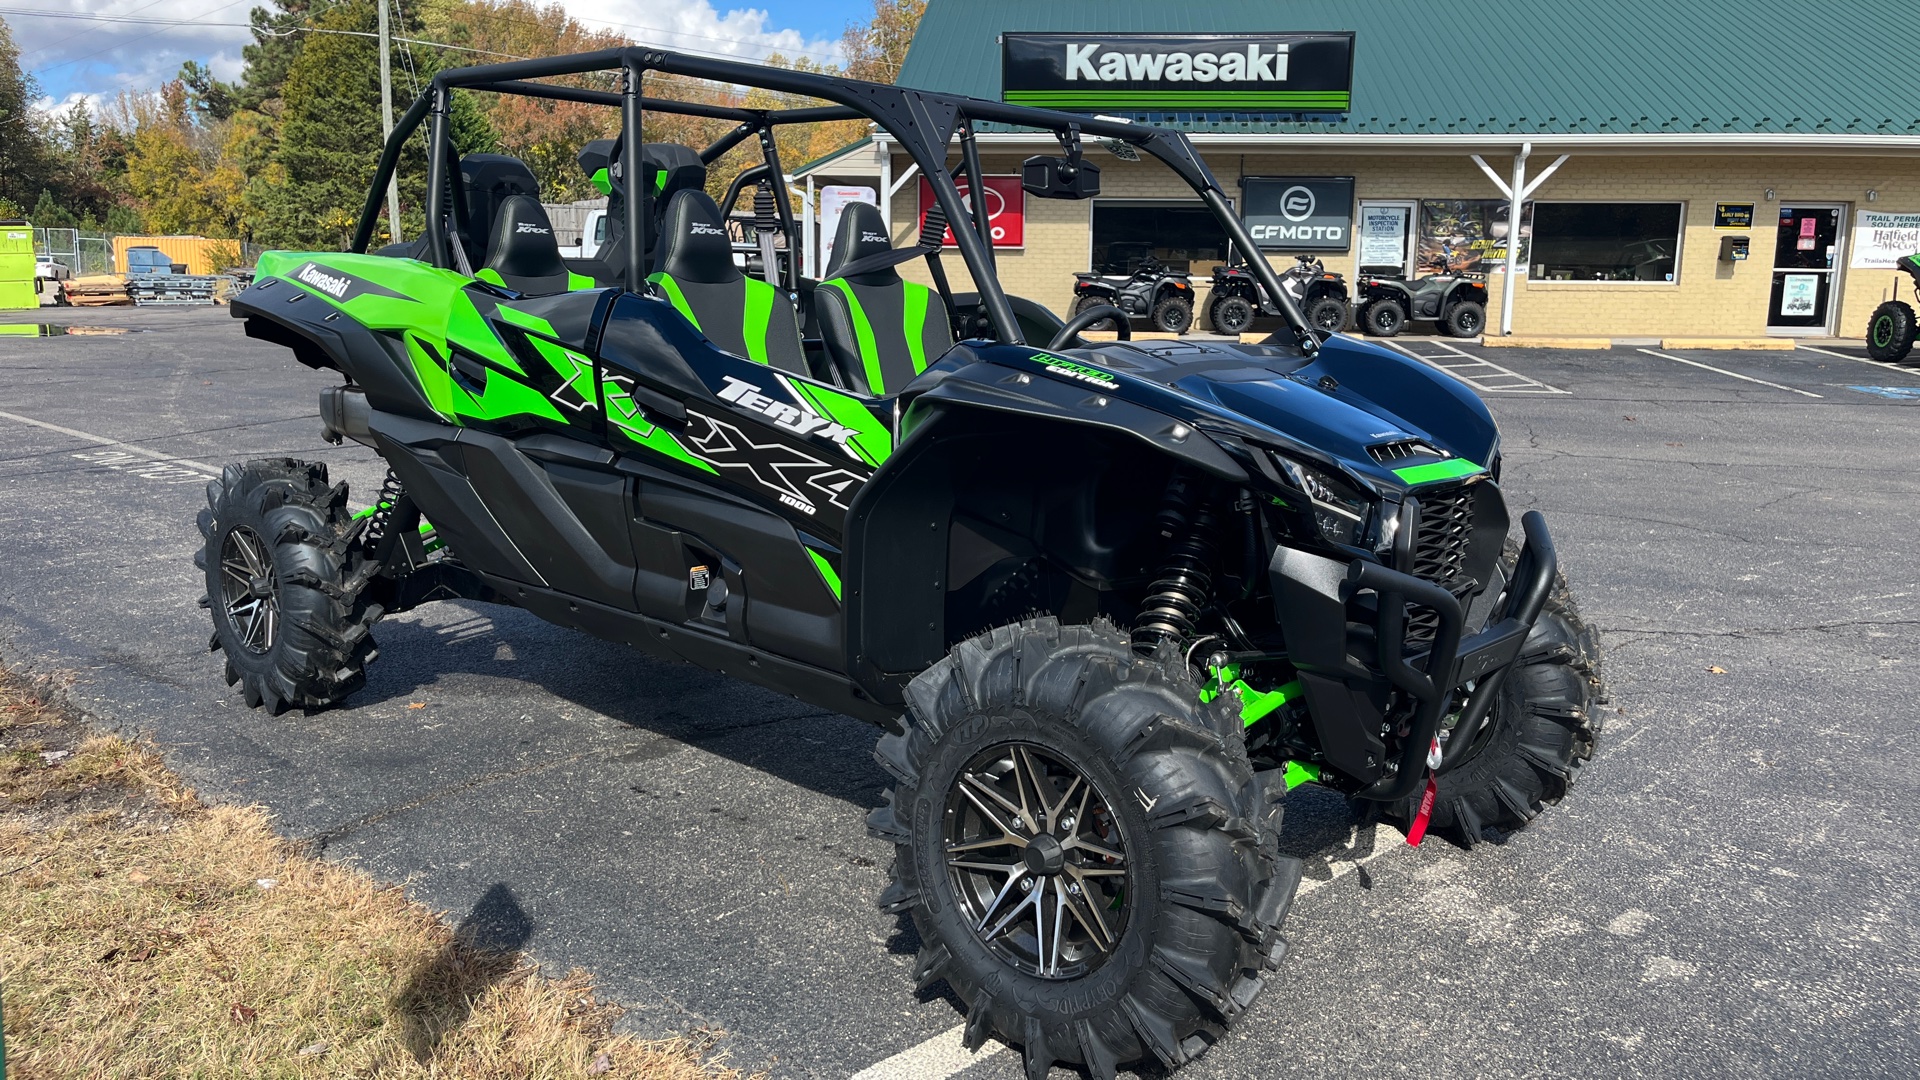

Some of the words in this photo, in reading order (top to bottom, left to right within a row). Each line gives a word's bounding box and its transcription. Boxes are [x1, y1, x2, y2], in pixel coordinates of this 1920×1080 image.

[1065, 43, 1290, 82] Kawasaki
[516, 226, 550, 234] KRX
[690, 227, 725, 235] KRX
[861, 235, 888, 243] KRX
[1251, 225, 1342, 240] CFMOTO
[1873, 229, 1919, 243] Hatfield
[298, 263, 352, 298] Kawasaki
[1045, 365, 1120, 390] EDITION
[716, 375, 863, 445] TERYX
[779, 493, 817, 516] 1000
[1419, 789, 1434, 817] WARN
